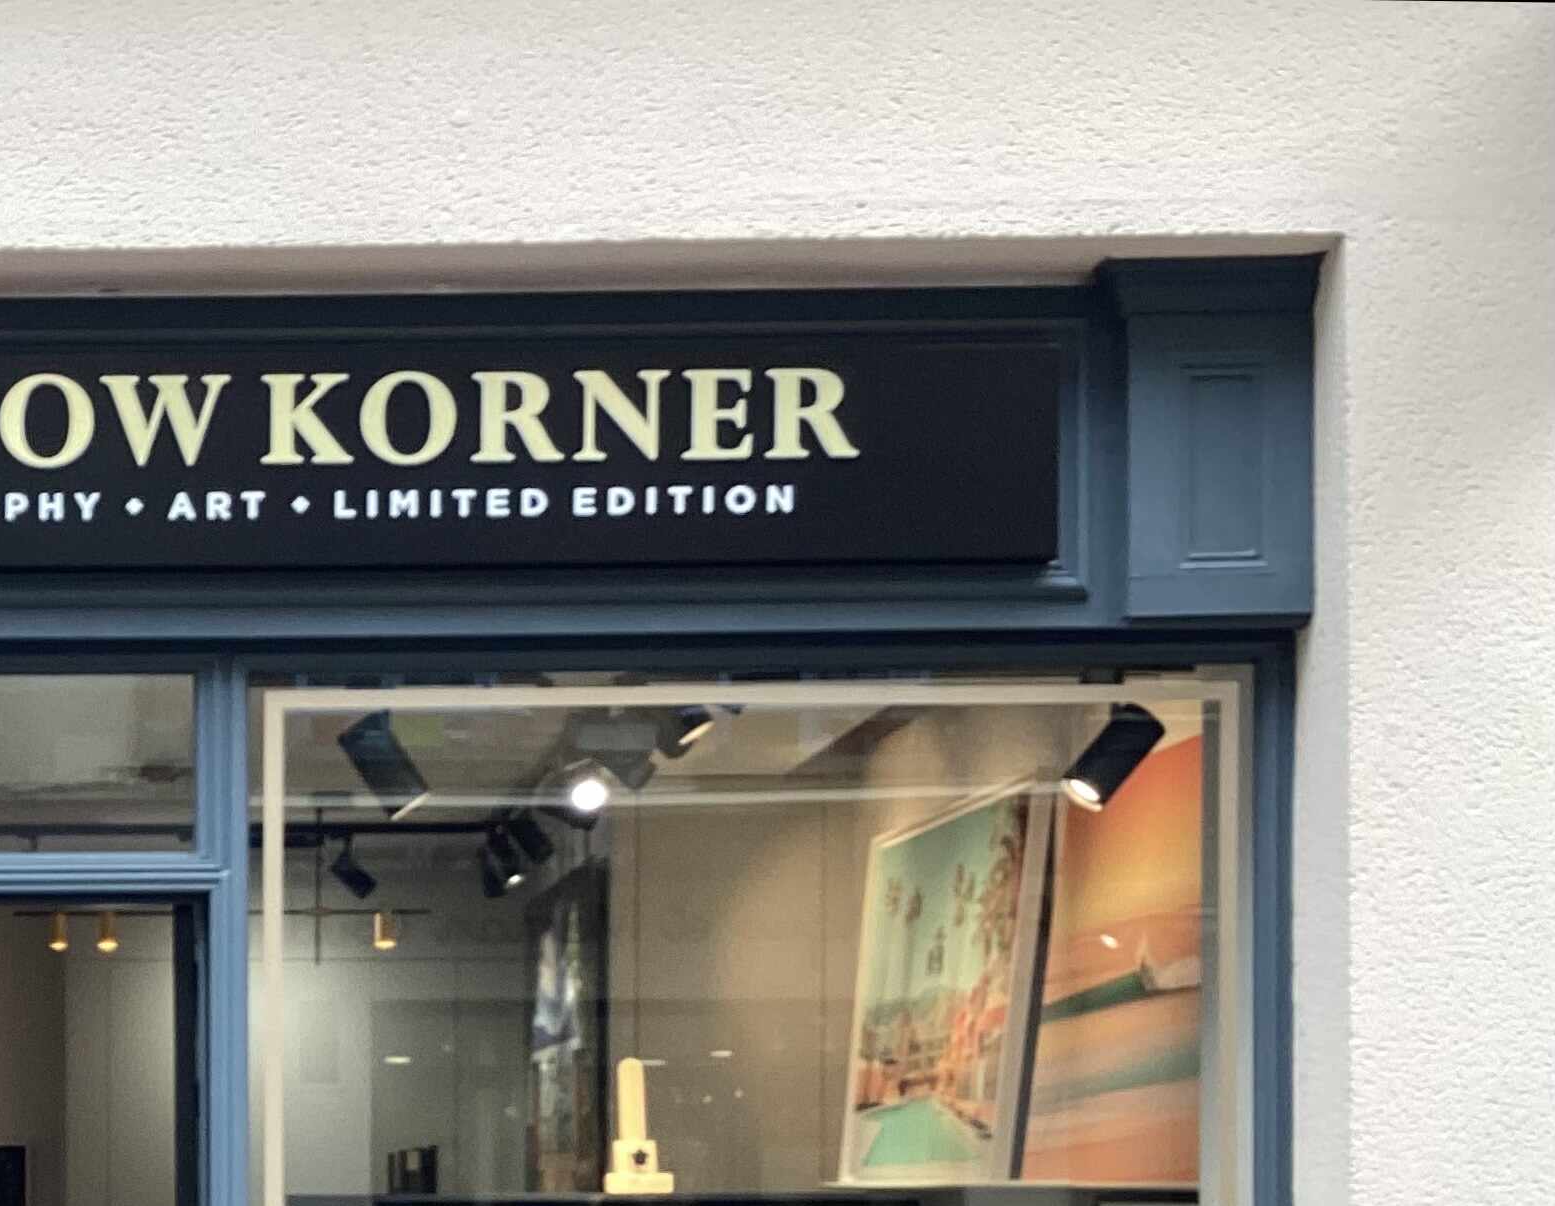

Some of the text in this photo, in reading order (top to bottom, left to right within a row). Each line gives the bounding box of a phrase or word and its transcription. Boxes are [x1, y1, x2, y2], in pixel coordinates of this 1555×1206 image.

[260, 367, 859, 466] KORNER
[167, 490, 266, 521] ART
[333, 487, 549, 519] LIMITED
[572, 484, 794, 517] EDITION
